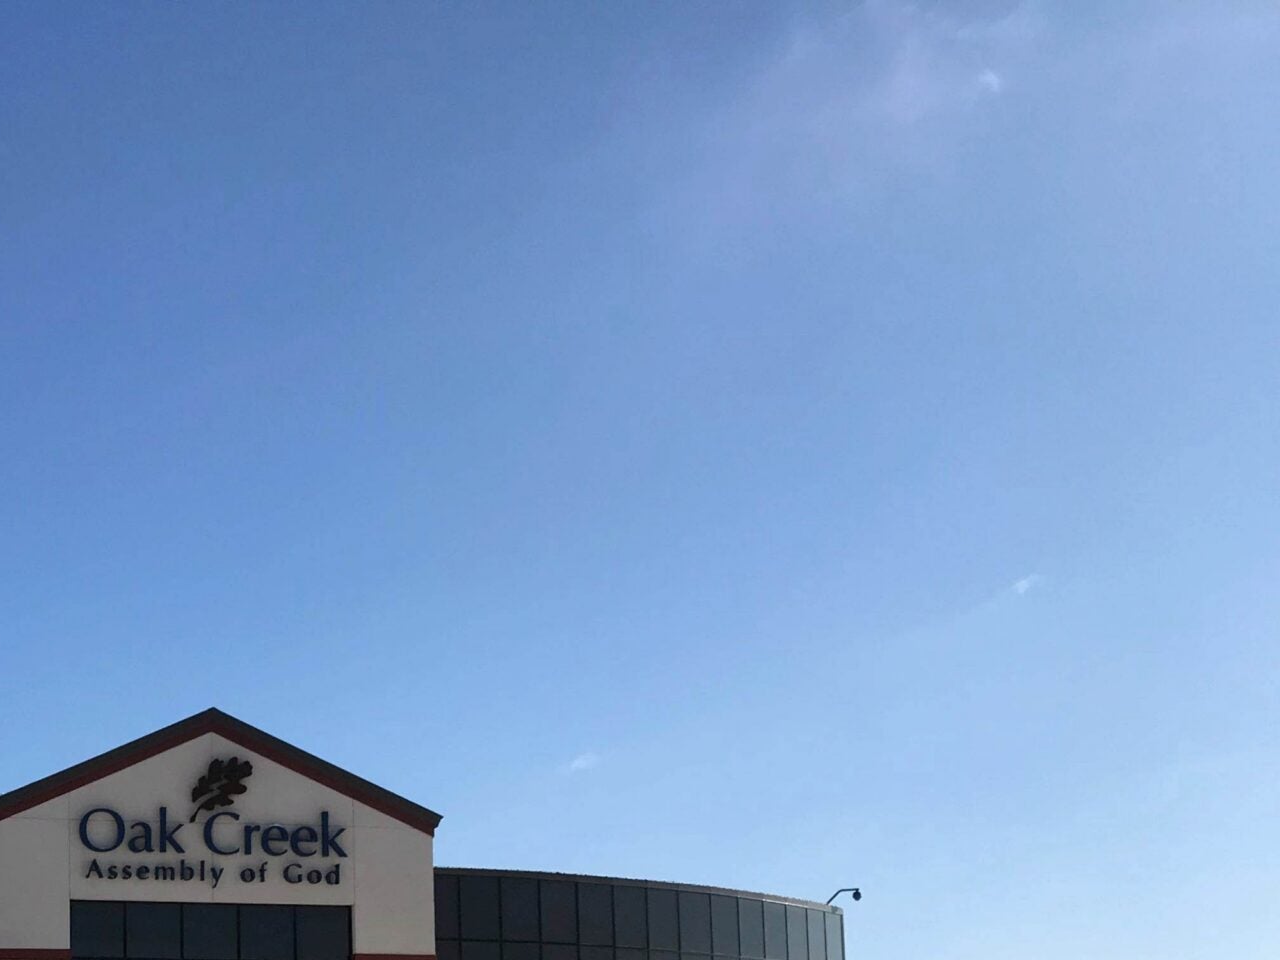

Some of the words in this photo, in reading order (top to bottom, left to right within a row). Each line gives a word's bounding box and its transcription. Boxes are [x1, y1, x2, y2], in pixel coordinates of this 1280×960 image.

[78, 806, 186, 854] Oak
[203, 811, 348, 859] Creek
[85, 857, 224, 889] Assembly
[239, 861, 269, 884] of
[282, 863, 342, 886] God
